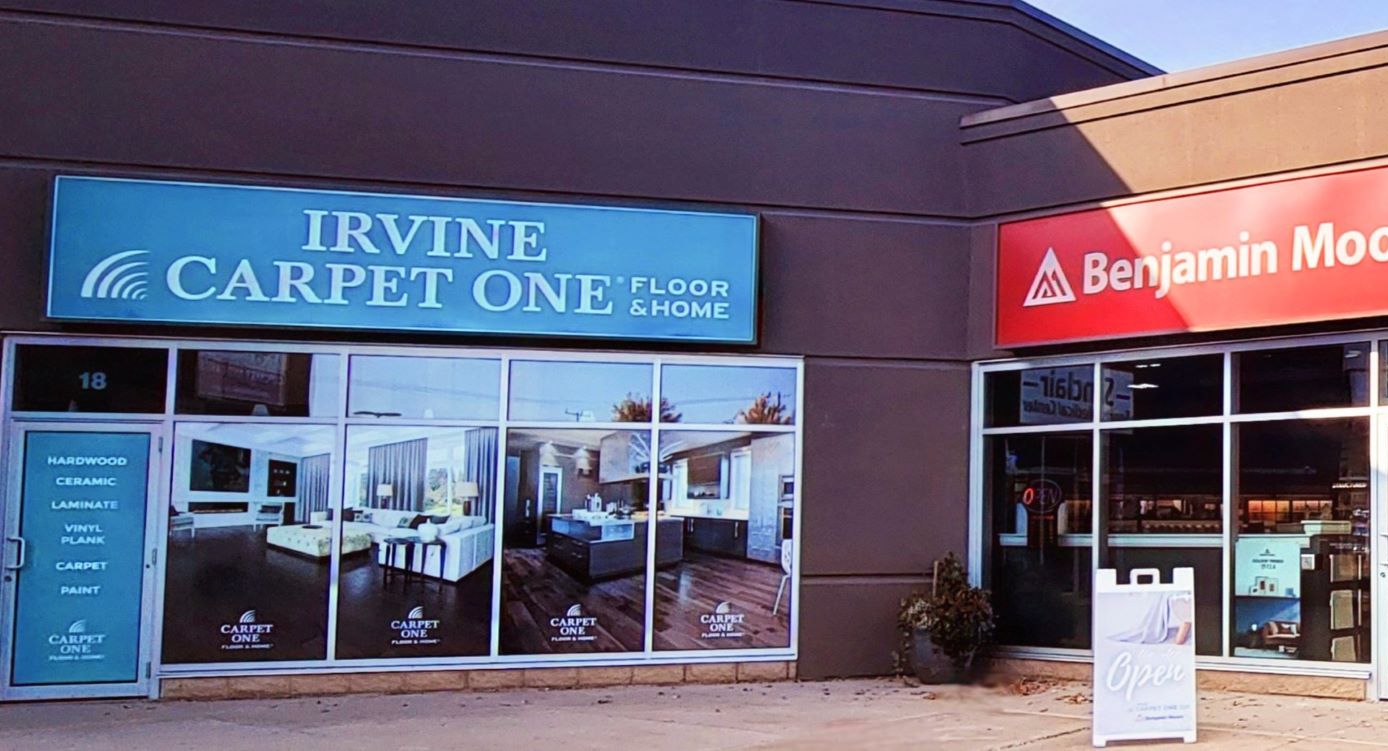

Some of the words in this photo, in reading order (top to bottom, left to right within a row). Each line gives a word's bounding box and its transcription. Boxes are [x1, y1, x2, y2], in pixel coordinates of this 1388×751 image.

[301, 209, 548, 262] IRVINE
[1082, 231, 1277, 298] Benjamin
[166, 256, 455, 308] CARPET
[629, 276, 730, 297] FLOOR
[629, 302, 730, 320] &HOME
[79, 372, 108, 390] 18
[48, 456, 127, 466] HARDWOOD
[56, 477, 117, 487] CERAMIC
[51, 500, 118, 510] LAMINATE
[65, 524, 103, 533] VINYL
[61, 536, 105, 545] PLANK
[56, 561, 108, 571] CARPET
[61, 586, 100, 595] PAINT
[550, 617, 598, 627] CARPET
[700, 614, 745, 624] CARPET
[220, 624, 274, 634] CARPET
[390, 620, 440, 630] CARPET
[710, 623, 734, 632] ONE
[400, 629, 429, 638] ONE
[560, 626, 586, 636] ONE
[48, 634, 106, 645] CARPET
[231, 634, 261, 643] ONE
[60, 644, 91, 654] ONE
[1106, 651, 1186, 702] Open
